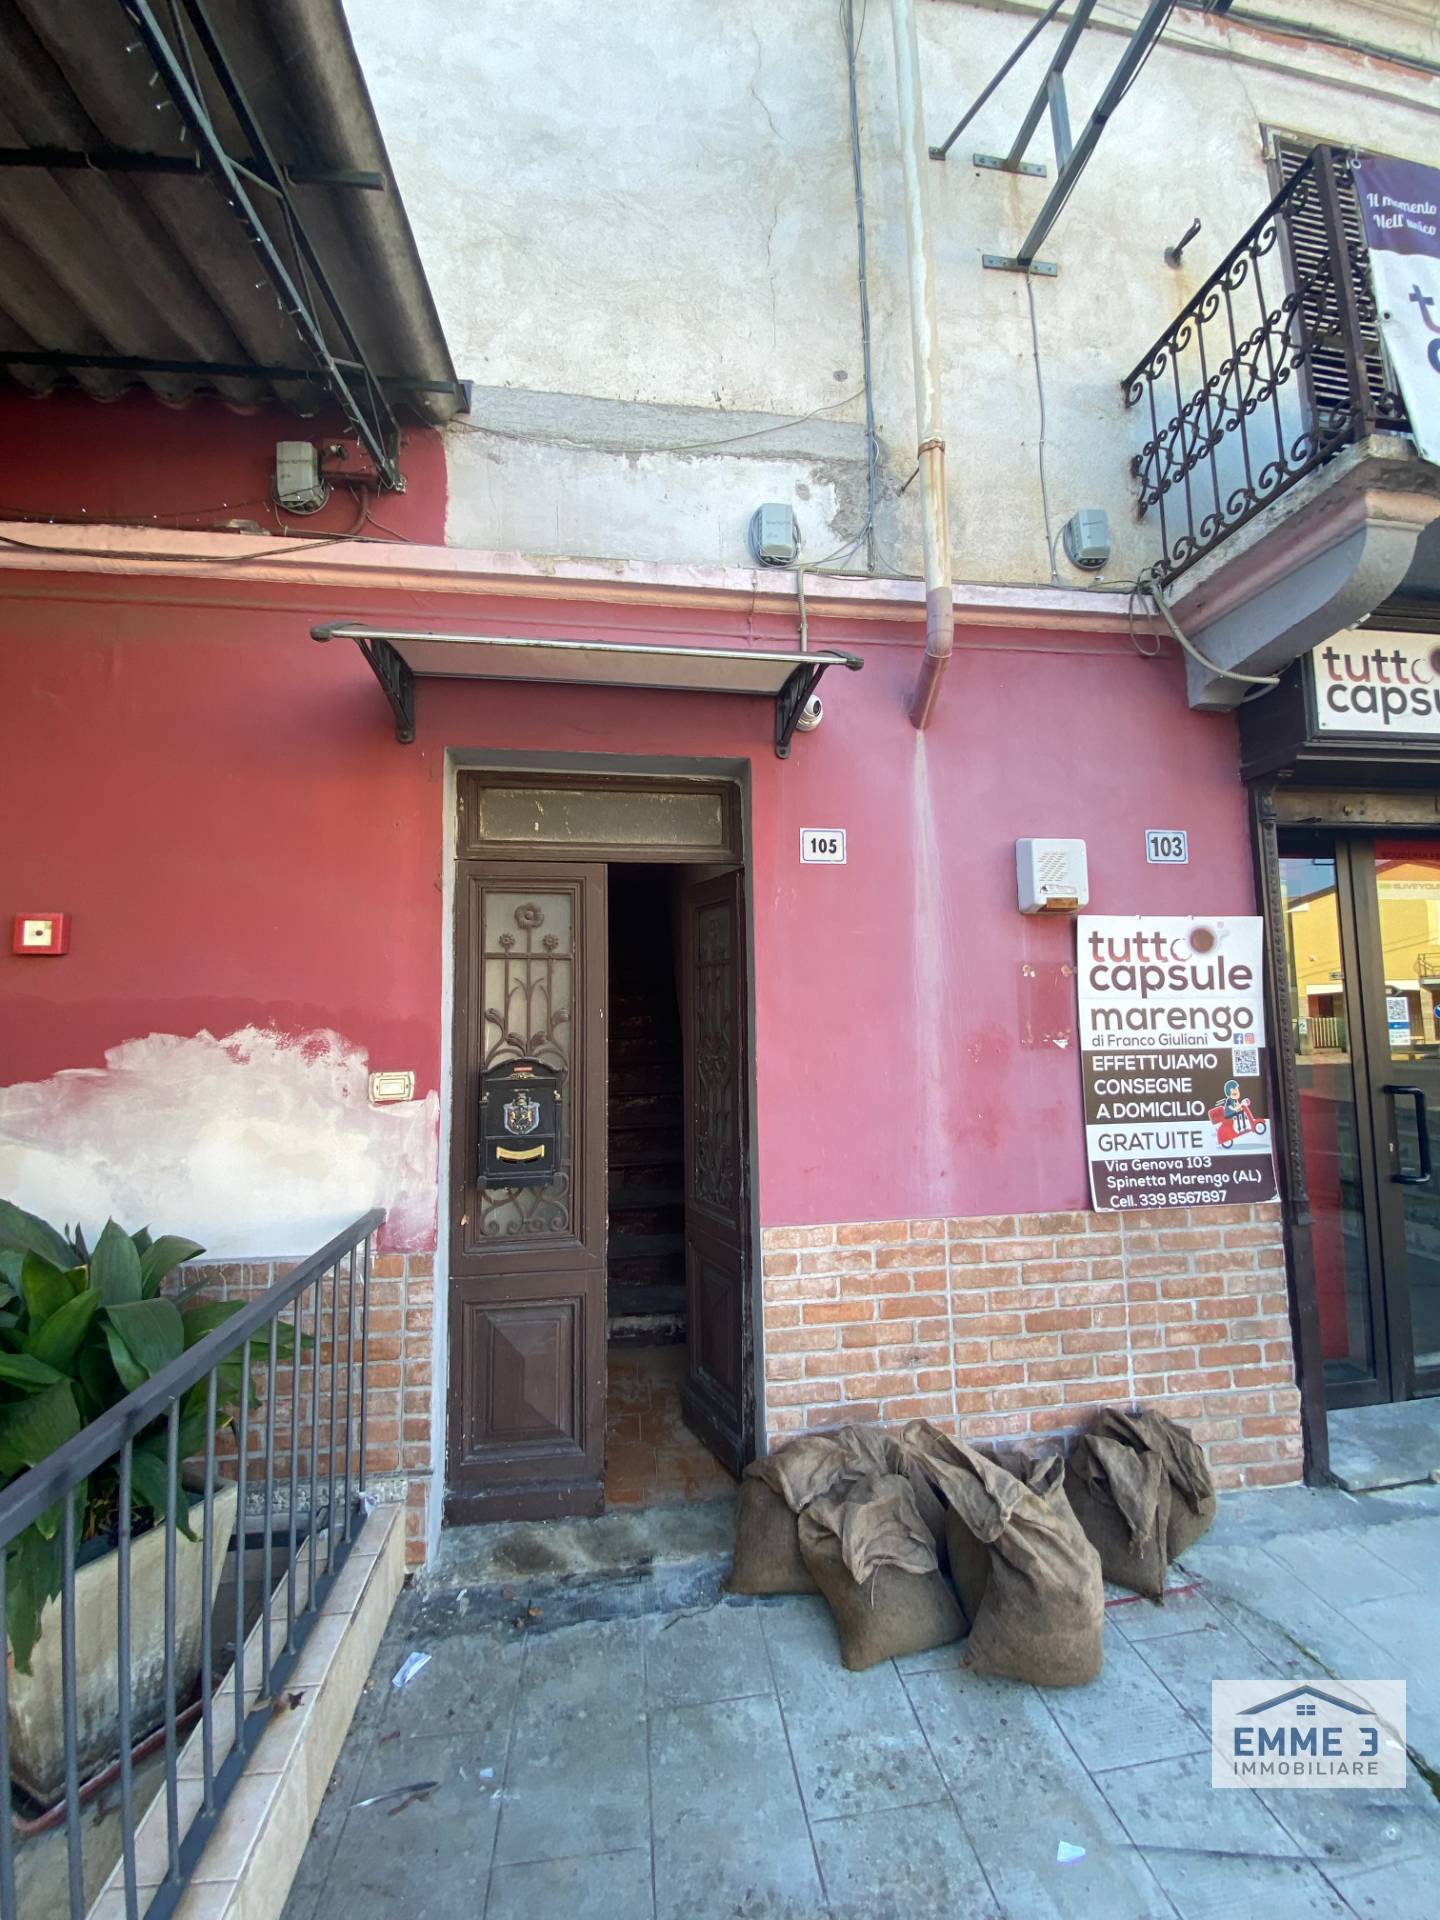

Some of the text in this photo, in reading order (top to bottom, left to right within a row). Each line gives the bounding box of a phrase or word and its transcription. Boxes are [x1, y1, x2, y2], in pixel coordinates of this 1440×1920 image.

[1327, 683, 1440, 725] caps
[810, 838, 837, 854] 105
[1151, 836, 1183, 857] 103
[1089, 955, 1253, 999] capsule
[1091, 1006, 1254, 1042] marengo
[1092, 1033, 1208, 1047] di Franco Giuliani
[1092, 1053, 1217, 1072] EFFETTUIAMO
[1094, 1078, 1193, 1095] CONSEGNE
[1096, 1100, 1205, 1119] A DOMICILIO
[1098, 1131, 1204, 1152] GRATUITE
[1104, 1156, 1212, 1173] Via Genova 103
[1106, 1169, 1262, 1191] Spinetta Marengo (AL)
[1110, 1190, 1227, 1208] Cell. 339 8567897
